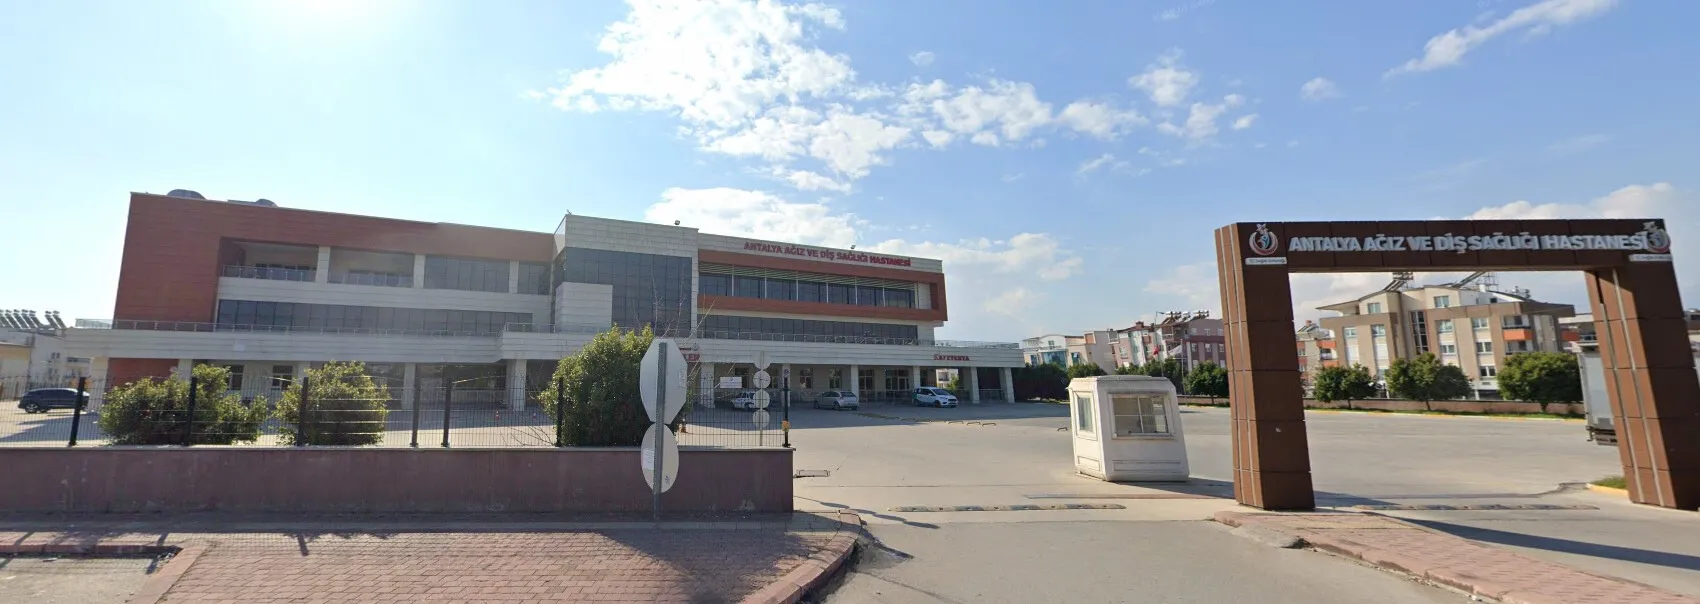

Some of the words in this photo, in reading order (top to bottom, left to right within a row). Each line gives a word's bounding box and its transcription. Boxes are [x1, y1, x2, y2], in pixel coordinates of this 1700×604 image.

[744, 242, 783, 254] ANTALYA
[784, 246, 805, 256] AĞIZ
[807, 249, 818, 258] VE
[821, 250, 834, 261] DİŞ
[837, 252, 868, 263] SAĞLIĞI
[870, 256, 911, 267] HASTANESİ
[1289, 237, 1361, 251] ANTALYA
[1364, 234, 1406, 250] AĞIZ
[1407, 236, 1432, 251] VE
[1434, 233, 1467, 254] DİŞ
[1469, 232, 1540, 250] SAĞLIĞI
[1540, 232, 1649, 250] HASTANESİ
